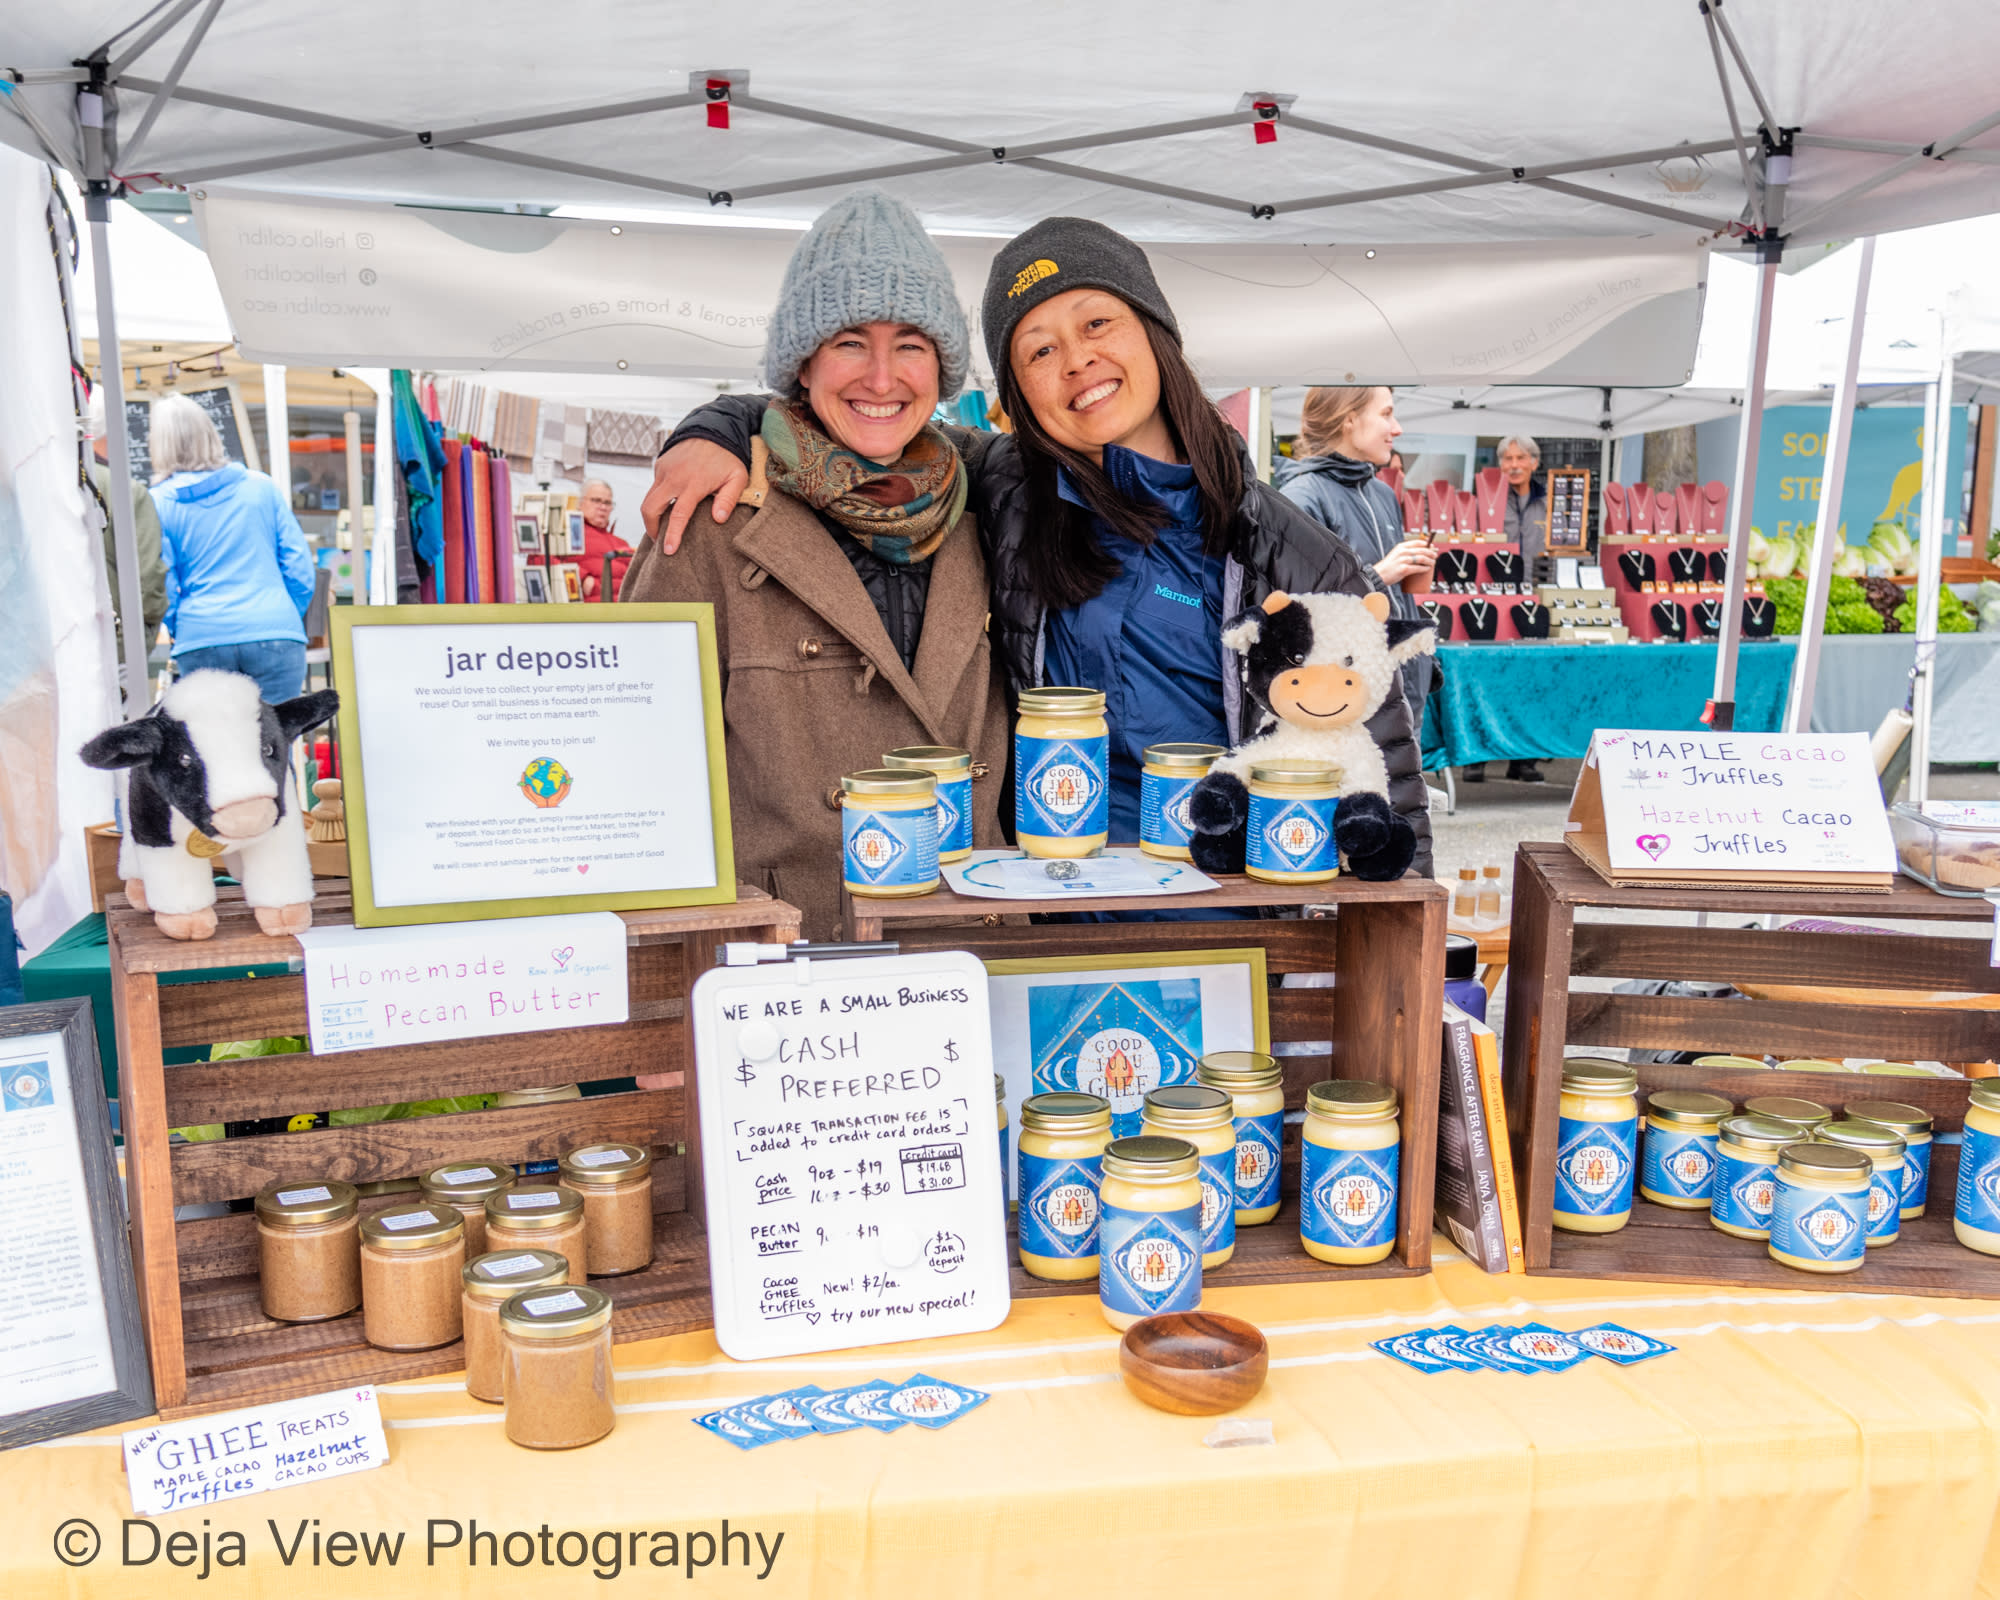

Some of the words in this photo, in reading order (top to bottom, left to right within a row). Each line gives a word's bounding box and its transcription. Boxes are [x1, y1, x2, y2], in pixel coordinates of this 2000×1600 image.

[1154, 583, 1202, 609] Marmot
[445, 646, 487, 678] jar
[496, 644, 620, 676] deposit!
[415, 686, 431, 695] We
[432, 685, 462, 695] would
[463, 685, 484, 694] love
[485, 685, 497, 694] to
[499, 684, 530, 694] collect
[532, 684, 554, 695] your
[555, 684, 585, 694] empty
[587, 682, 604, 694] jars
[606, 681, 615, 691] of
[617, 682, 639, 692] ghee
[640, 681, 653, 690] for
[419, 699, 450, 709] reuse!
[451, 699, 469, 709] Our
[472, 698, 497, 708] small
[499, 697, 540, 707] business
[542, 697, 549, 706] is
[551, 695, 589, 705] focused
[590, 696, 602, 705] on
[603, 694, 653, 705] minimizing
[476, 713, 492, 721] our
[495, 711, 528, 722] impact
[529, 711, 542, 719] on
[544, 711, 572, 719] mama
[574, 709, 600, 718] earth.
[486, 738, 502, 747] We
[503, 737, 530, 746] invite
[531, 738, 549, 748] you
[551, 737, 561, 745] to
[562, 736, 581, 747] join
[582, 735, 596, 744] us!
[1632, 740, 1742, 761] MAPLE
[1760, 744, 1847, 762] Cacao
[1049, 768, 1082, 778] GOOD
[1044, 790, 1086, 806] GHEE
[1640, 804, 1764, 825] Hazelnut
[1782, 809, 1853, 826] Cacao
[330, 954, 506, 989] Homemade
[384, 1001, 468, 1028] Pecan
[489, 986, 601, 1017] Butter
[722, 1004, 750, 1021] WE
[764, 1000, 803, 1018] ARE
[819, 998, 831, 1013] A
[840, 994, 892, 1013] SMALL
[779, 1031, 861, 1063] CASH
[943, 1037, 960, 1063] $
[1094, 1038, 1142, 1053] GOOD
[1455, 1025, 1475, 1094] FRAGRANCE
[734, 1058, 757, 1088] $
[780, 1066, 941, 1102] PREFERRED
[1088, 1074, 1149, 1099] GHEE
[1489, 1073, 1499, 1096] dear
[1465, 1094, 1481, 1128] AFTER
[747, 1122, 802, 1138] SQUARE
[810, 1112, 899, 1132] TRANSACTION
[750, 1138, 791, 1153] added
[800, 1136, 818, 1149] to
[828, 1129, 871, 1144] credit
[876, 1125, 906, 1139] card
[912, 1122, 952, 1137] orders
[1471, 1128, 1486, 1159] RAIN
[904, 1148, 935, 1161] credit
[936, 1146, 959, 1160] card
[1579, 1150, 1613, 1159] GOOD
[808, 1164, 836, 1183] 9oz
[856, 1158, 883, 1180] $19
[916, 1161, 952, 1175] $19.68
[755, 1175, 788, 1189] Cash
[917, 1175, 954, 1190] $31.00
[1339, 1179, 1373, 1189] GOOD
[1477, 1169, 1490, 1198] JAIYA
[1572, 1170, 1616, 1186] GHEE
[759, 1186, 793, 1203] price
[861, 1181, 891, 1201] $30
[1055, 1188, 1090, 1198] GOOD
[1333, 1200, 1376, 1217] GHEE
[1481, 1197, 1497, 1230] JOHN
[1050, 1209, 1093, 1227] GHEE
[856, 1223, 880, 1240] $19
[934, 1230, 954, 1244] $1
[758, 1239, 800, 1253] Butter
[933, 1243, 956, 1255] JAR
[1136, 1242, 1173, 1252] GOOD
[928, 1254, 966, 1269] deposit
[763, 1276, 799, 1289] Cacao
[1130, 1265, 1177, 1283] GHEE
[764, 1287, 801, 1301] GHEE
[823, 1276, 855, 1296] New!
[759, 1297, 816, 1315] truffles
[830, 1307, 854, 1324] try
[859, 1306, 881, 1318] our
[885, 1301, 914, 1316] new
[918, 1289, 976, 1316] special!
[355, 1391, 371, 1402] $2
[131, 1429, 161, 1456] NEW!
[157, 1421, 268, 1470] GHEE
[276, 1410, 350, 1442] TREATS
[275, 1434, 367, 1468] Hazelnut
[153, 1470, 208, 1490] MAPLE
[215, 1460, 261, 1479] CACAO
[275, 1461, 328, 1482] CACAO
[335, 1450, 370, 1467] CUPS
